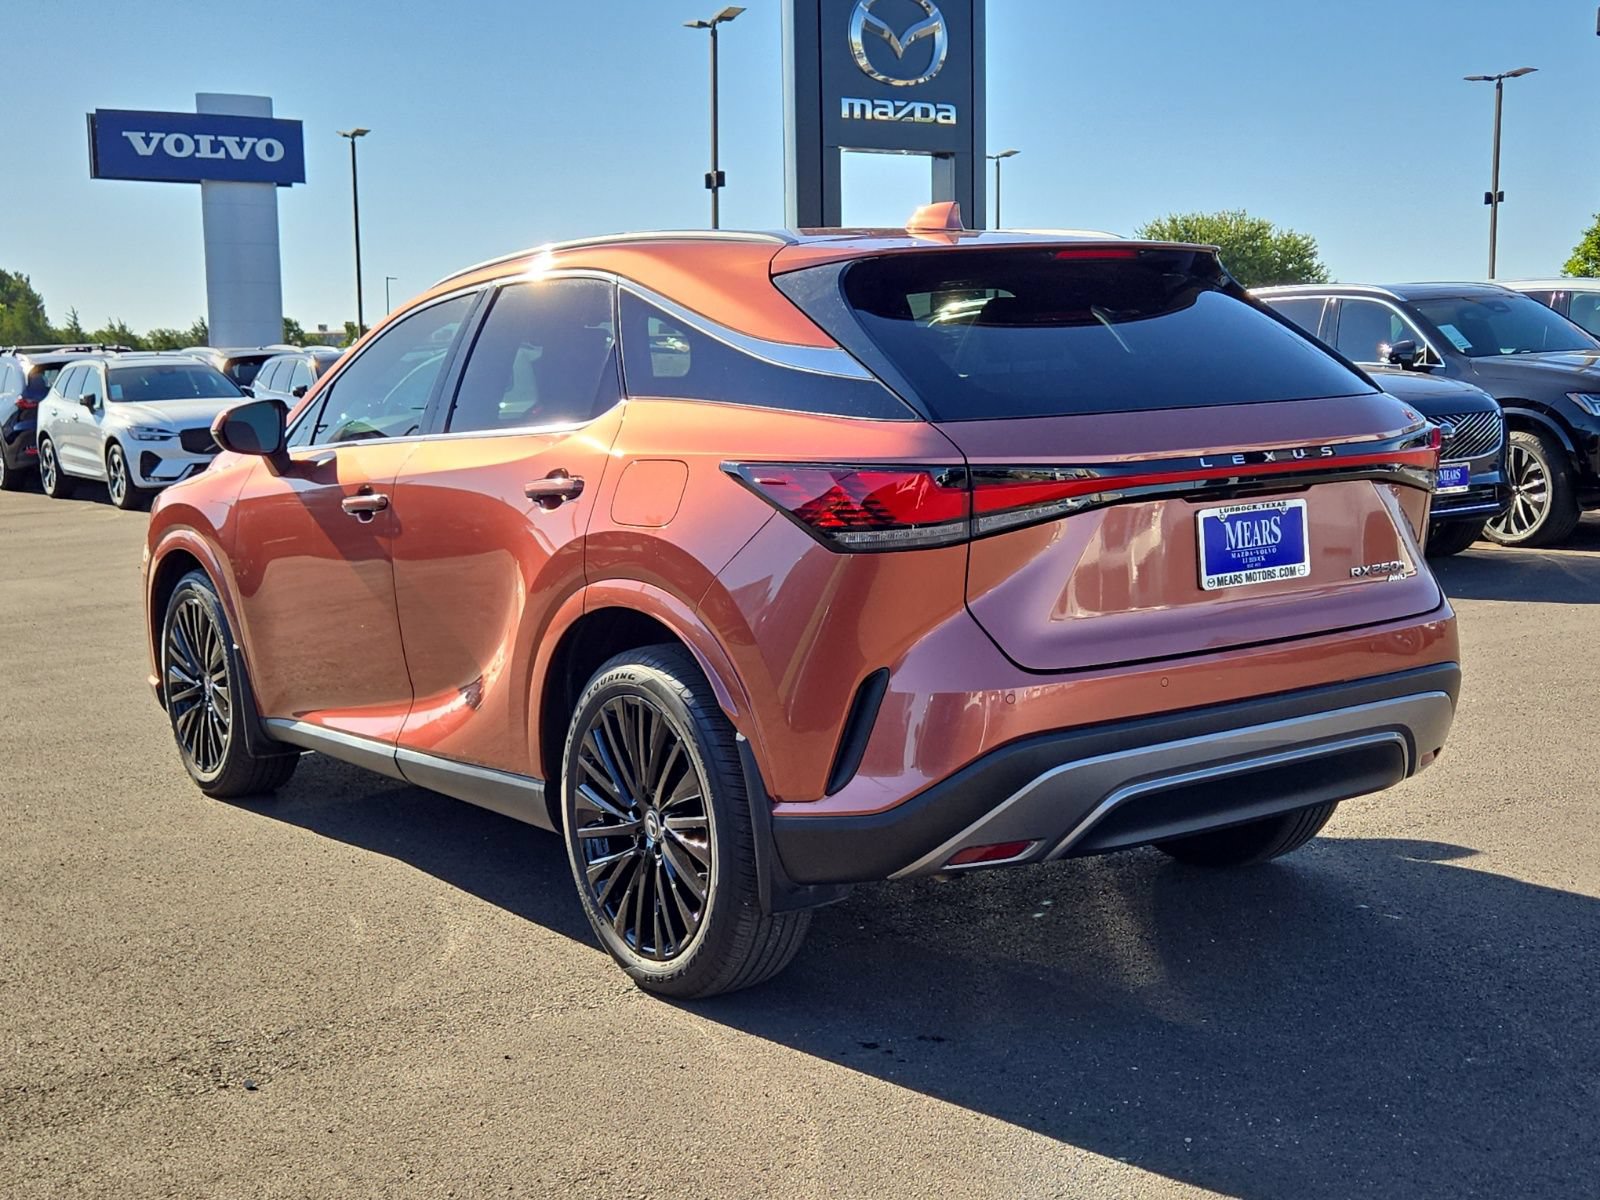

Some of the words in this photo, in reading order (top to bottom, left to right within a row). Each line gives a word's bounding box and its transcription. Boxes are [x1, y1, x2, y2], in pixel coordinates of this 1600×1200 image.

[122, 131, 285, 162] VOLVO
[1200, 446, 1333, 468] LEXUS
[1224, 515, 1282, 551] MEARS
[1217, 573, 1243, 587] MEARS
[1245, 566, 1297, 583] MOTORS.COM
[587, 672, 636, 699] TOURING
